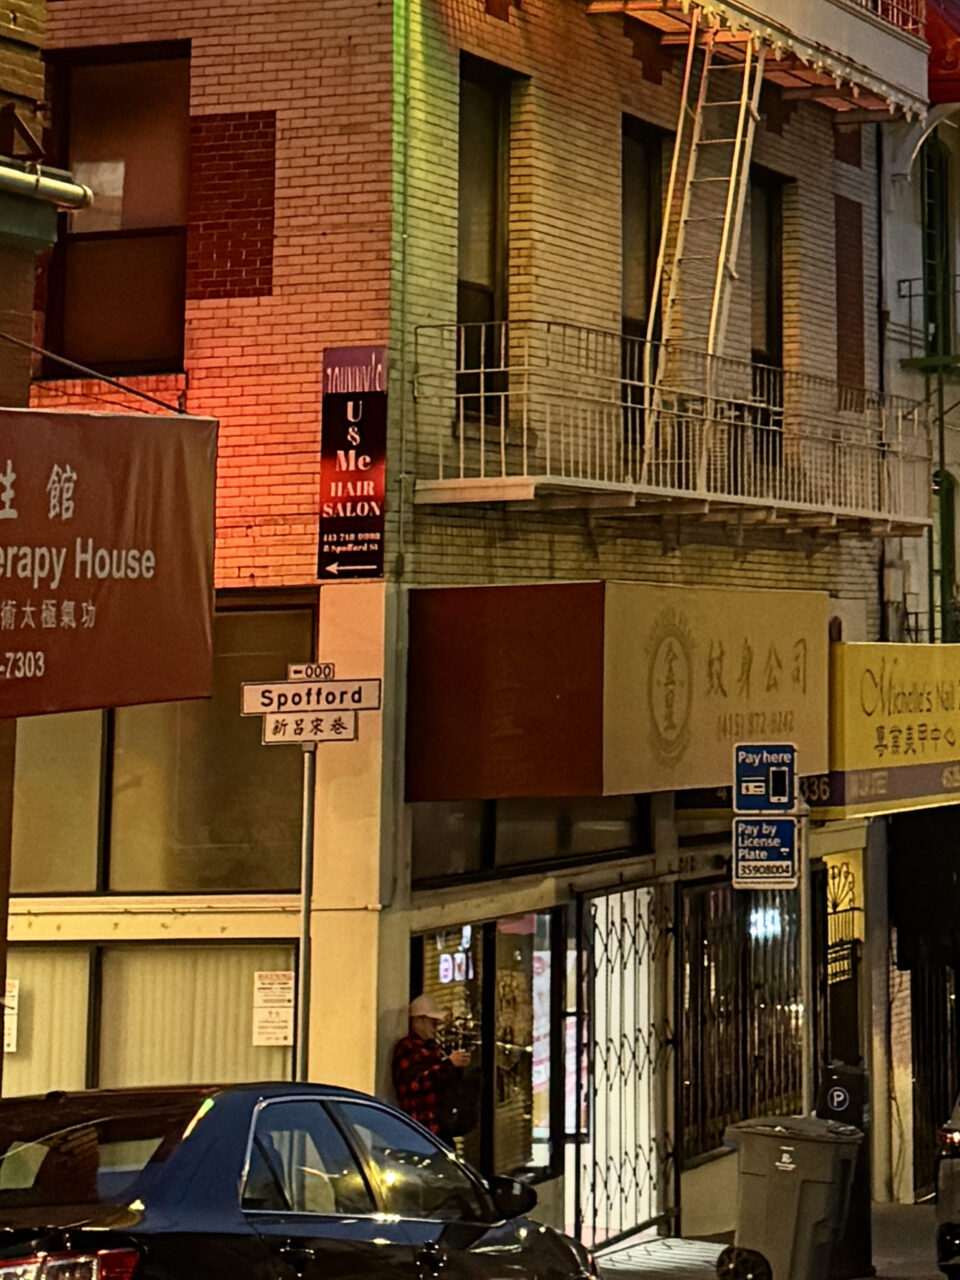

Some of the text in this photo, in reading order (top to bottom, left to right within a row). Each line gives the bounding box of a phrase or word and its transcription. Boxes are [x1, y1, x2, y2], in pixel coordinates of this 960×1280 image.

[346, 400, 363, 423] U
[346, 426, 361, 446] &
[335, 449, 371, 471] Me
[330, 480, 375, 498] HAIR
[322, 501, 382, 518] SALON
[75, 536, 156, 580] House
[260, 686, 363, 711] Spofford
[272, 716, 349, 737] 新呂宋巷
[738, 749, 792, 767] Pay here
[738, 822, 777, 837] Pay by
[738, 835, 781, 848] License
[738, 847, 769, 860] Plate
